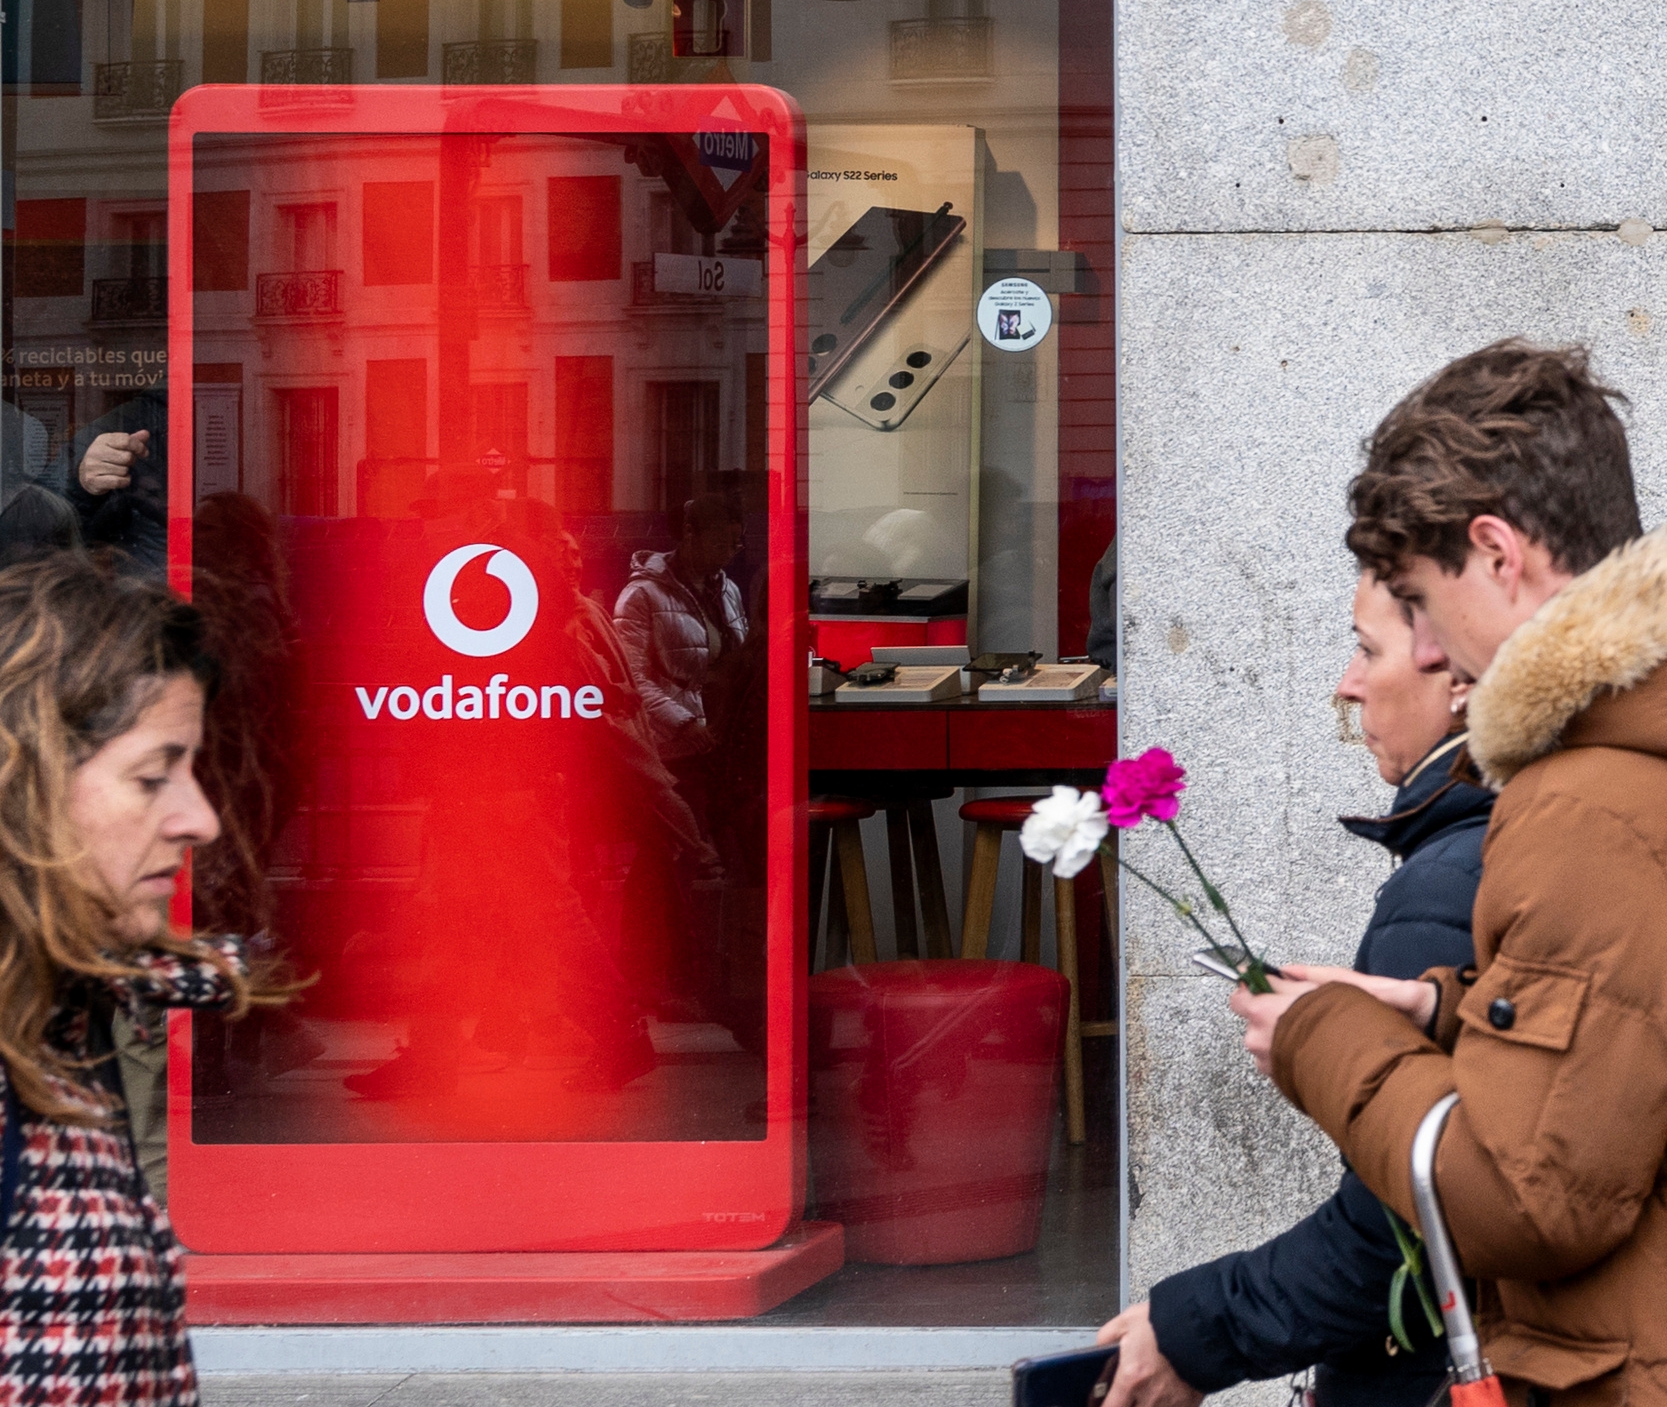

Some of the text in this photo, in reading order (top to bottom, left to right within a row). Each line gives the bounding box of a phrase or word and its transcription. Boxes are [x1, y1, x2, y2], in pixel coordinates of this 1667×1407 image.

[806, 170, 898, 182] alaxy S22 Series
[19, 346, 126, 364] reciclables
[131, 350, 168, 369] que
[57, 373, 71, 391] y
[74, 374, 84, 387] a
[89, 371, 111, 387] tu
[355, 673, 604, 720] vodafone
[701, 1212, 765, 1222] TOTEM
